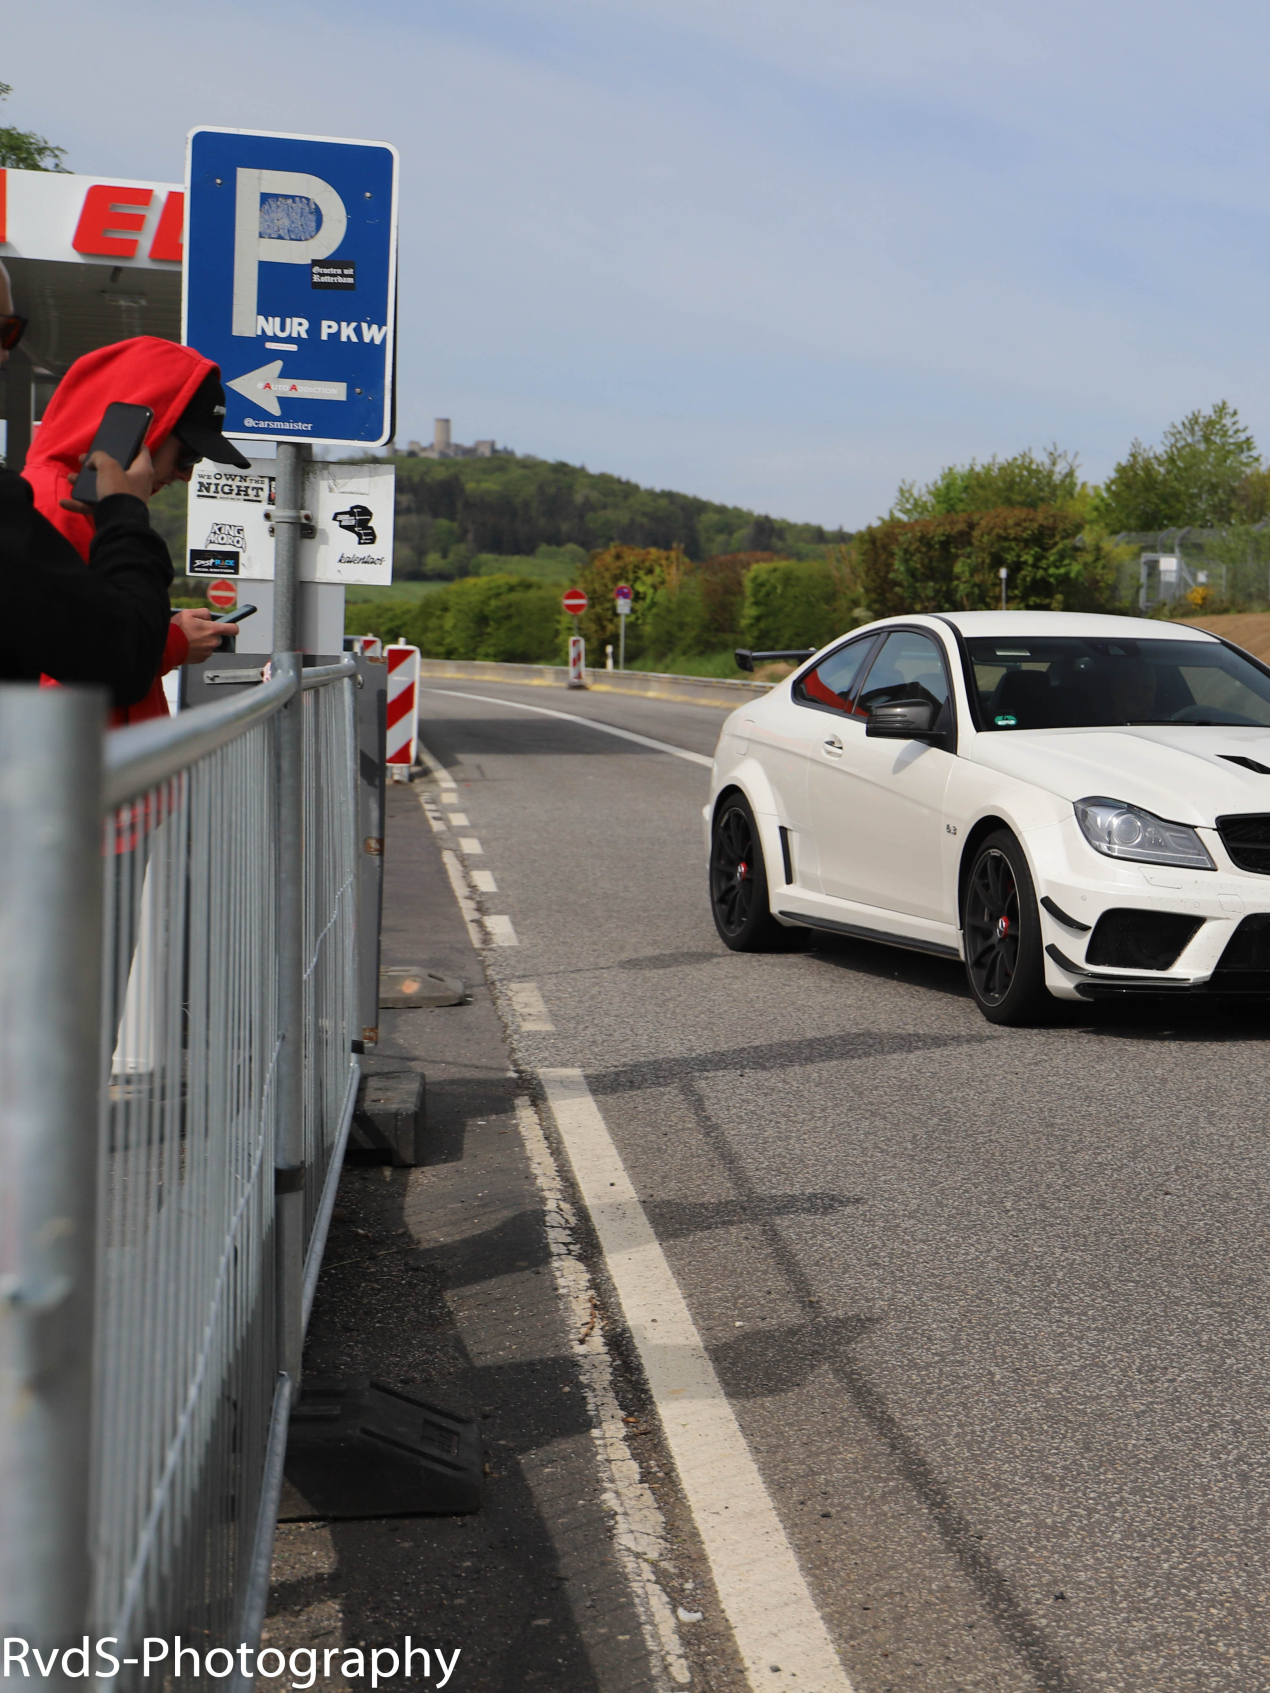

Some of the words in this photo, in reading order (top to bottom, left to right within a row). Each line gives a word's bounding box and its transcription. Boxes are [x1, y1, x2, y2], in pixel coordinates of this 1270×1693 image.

[232, 167, 348, 337] P
[312, 274, 355, 284] Rotterdam
[257, 315, 309, 338] NUR
[320, 320, 387, 345] PKW
[244, 417, 313, 431] @carsmaister
[213, 473, 248, 482] OWN
[197, 481, 264, 498] NIGHT
[211, 523, 244, 539] KING
